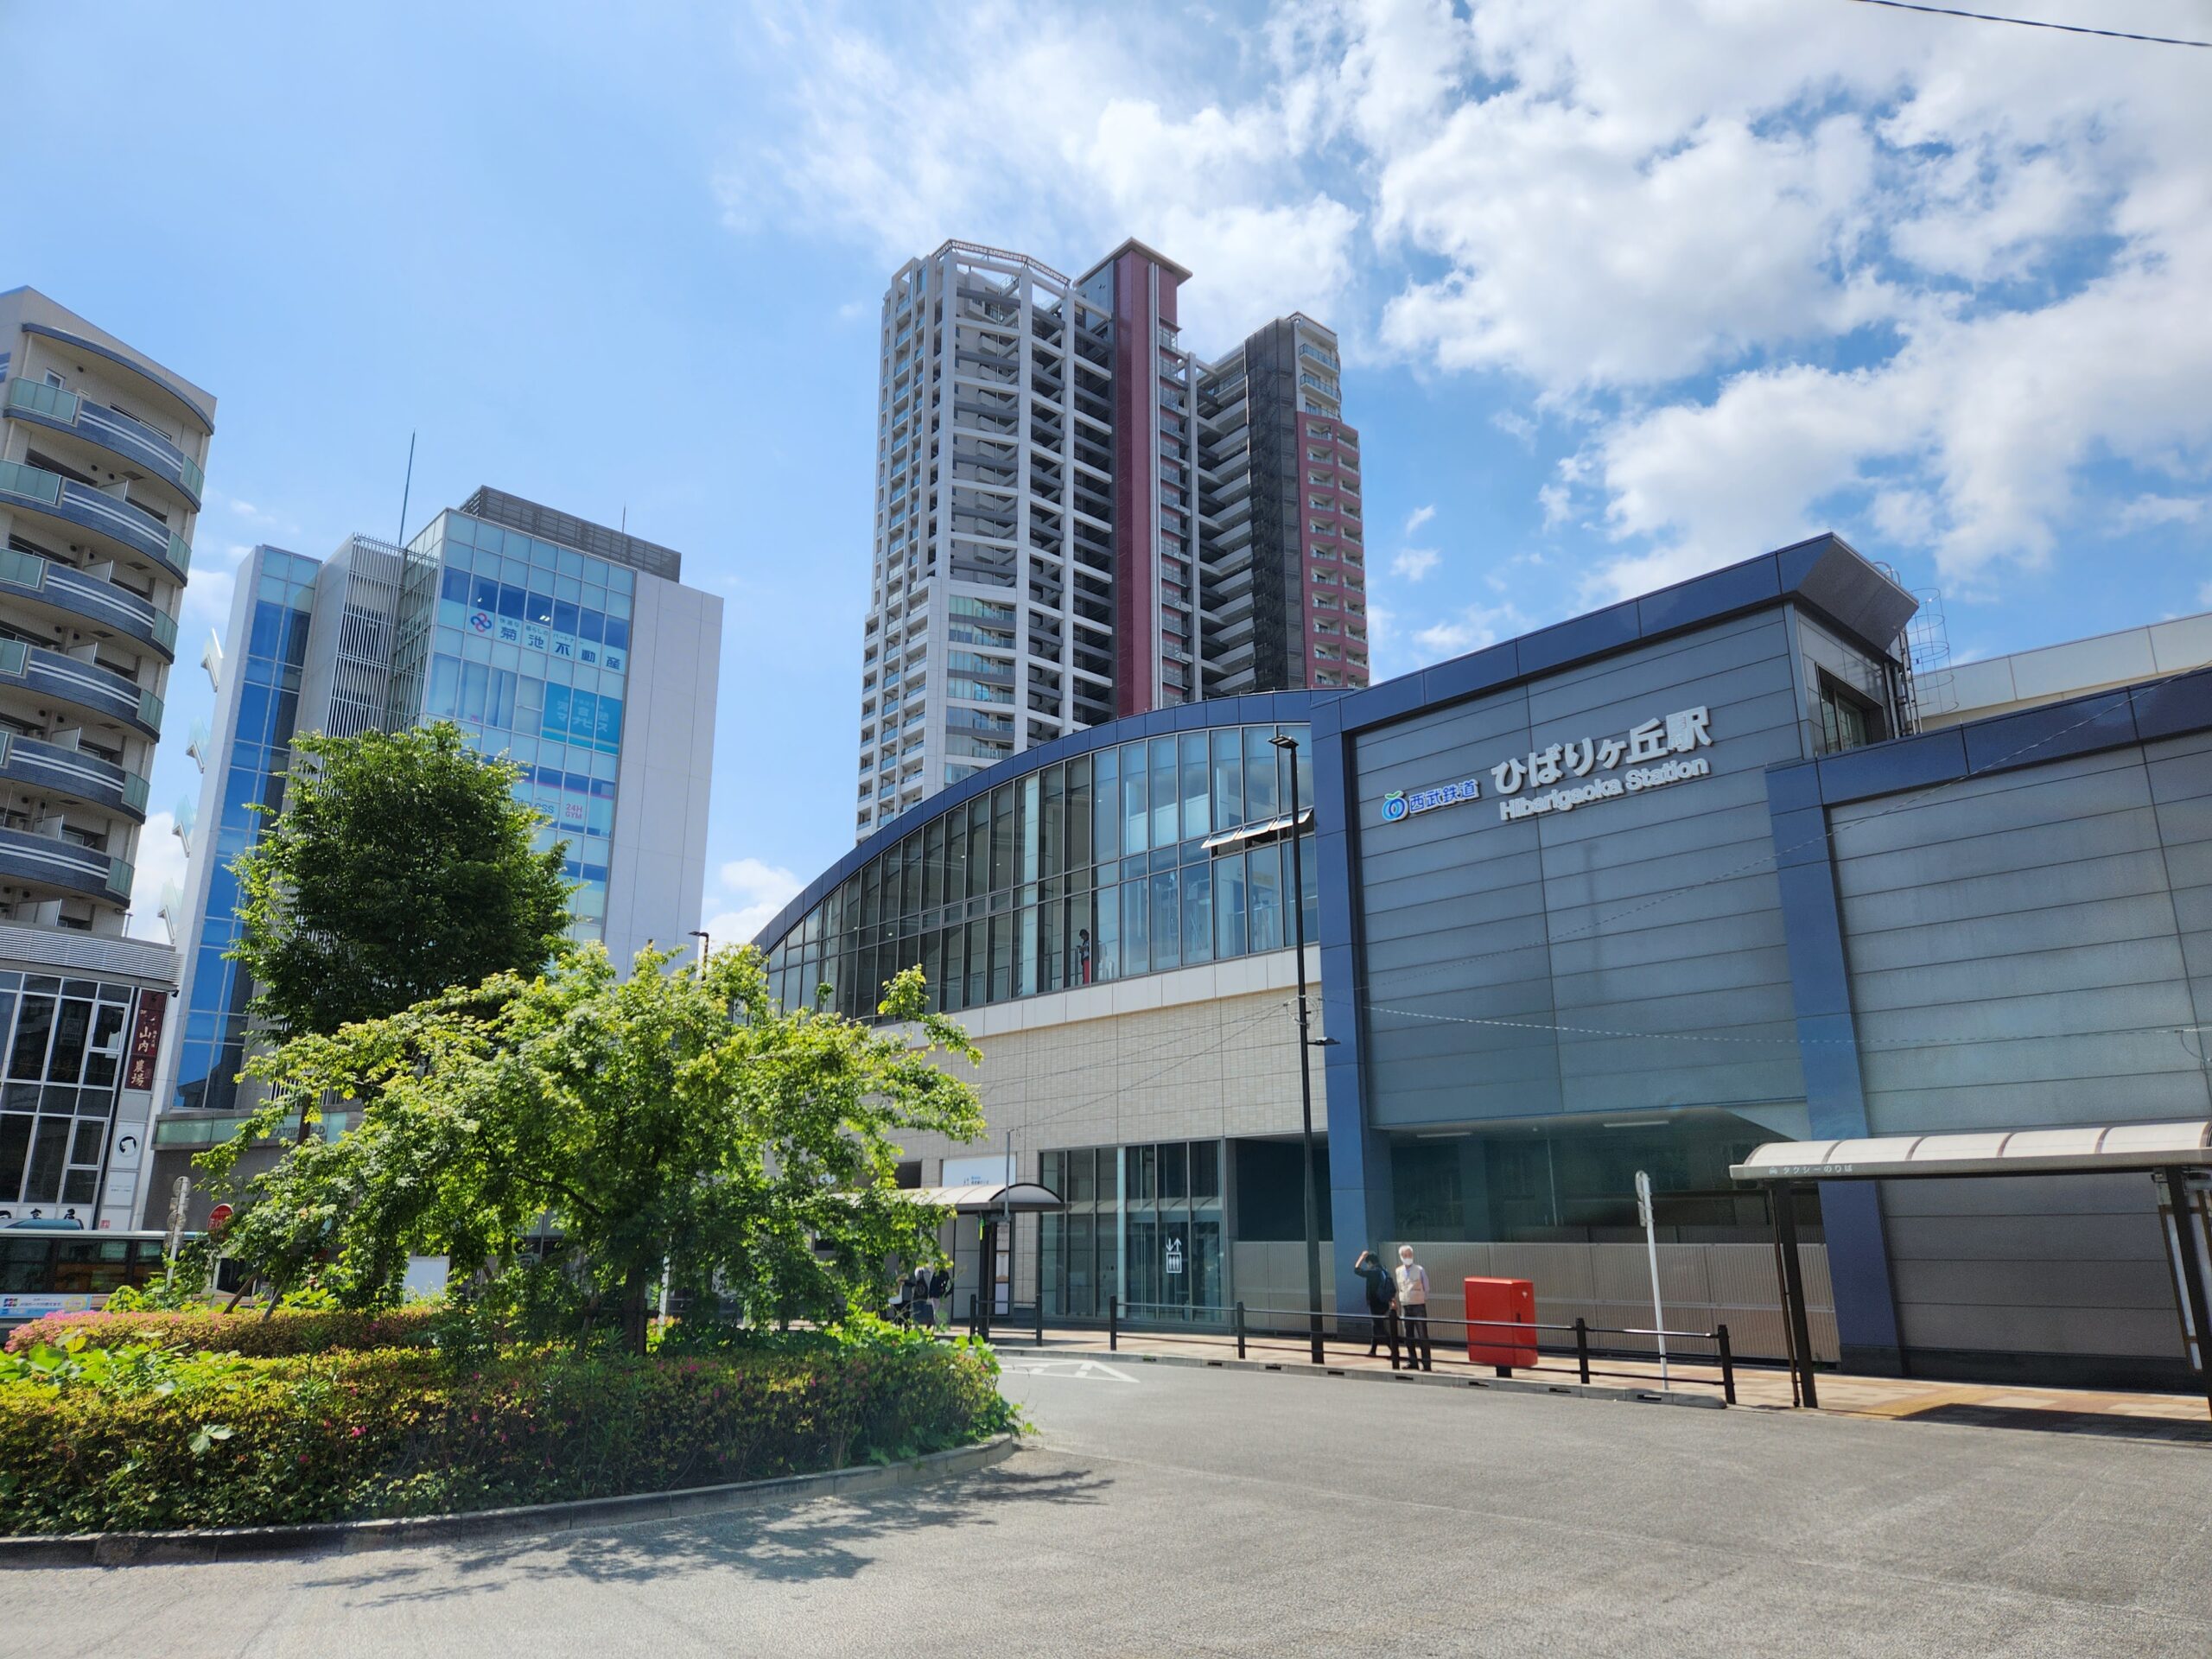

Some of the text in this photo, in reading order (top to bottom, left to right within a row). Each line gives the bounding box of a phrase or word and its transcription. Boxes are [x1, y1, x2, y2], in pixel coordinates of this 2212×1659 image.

[500, 626, 620, 670] 菊池不動産
[1410, 779, 1478, 813] 西武鉄道
[1500, 758, 1710, 821] Hibarigaoka Station
[565, 811, 582, 820] GYM
[566, 804, 582, 812] 24H
[130, 1026, 151, 1087] 山内農場
[1783, 1164, 1853, 1175] タクシーのりば
